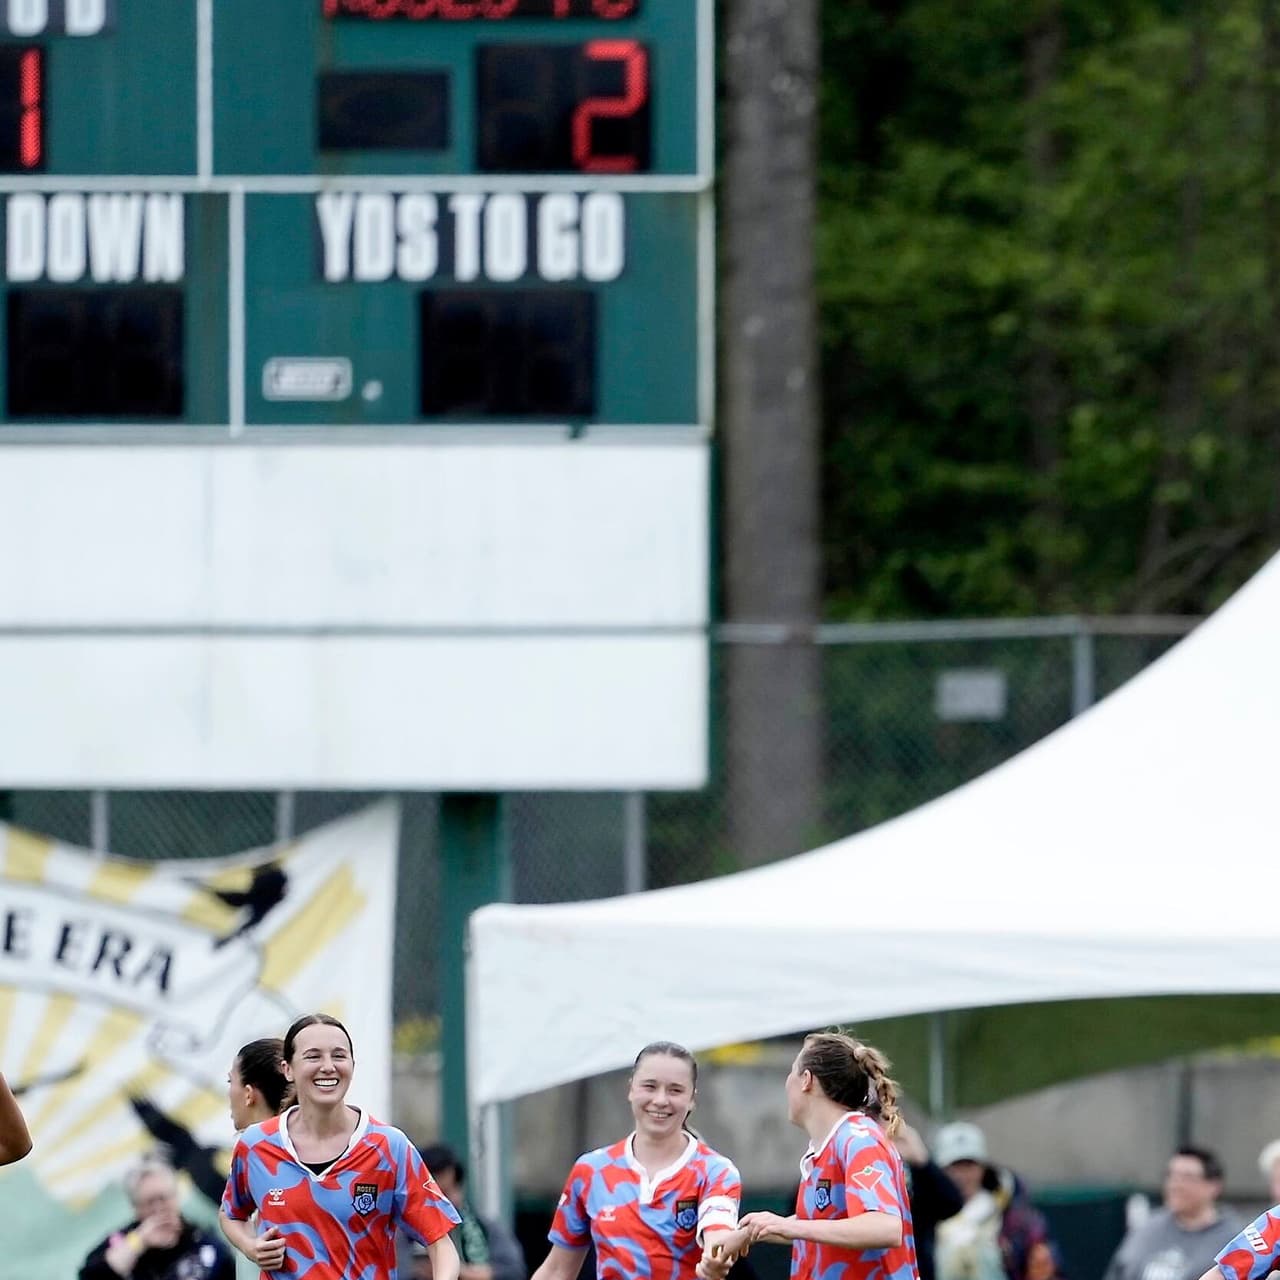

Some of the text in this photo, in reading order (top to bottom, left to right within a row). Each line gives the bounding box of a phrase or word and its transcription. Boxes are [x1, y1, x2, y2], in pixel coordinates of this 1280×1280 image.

[19, 48, 41, 169] 1
[571, 38, 648, 173] 2
[5, 191, 185, 284] DOWN
[315, 191, 626, 283] YDS TO GO
[54, 919, 175, 997] ERA
